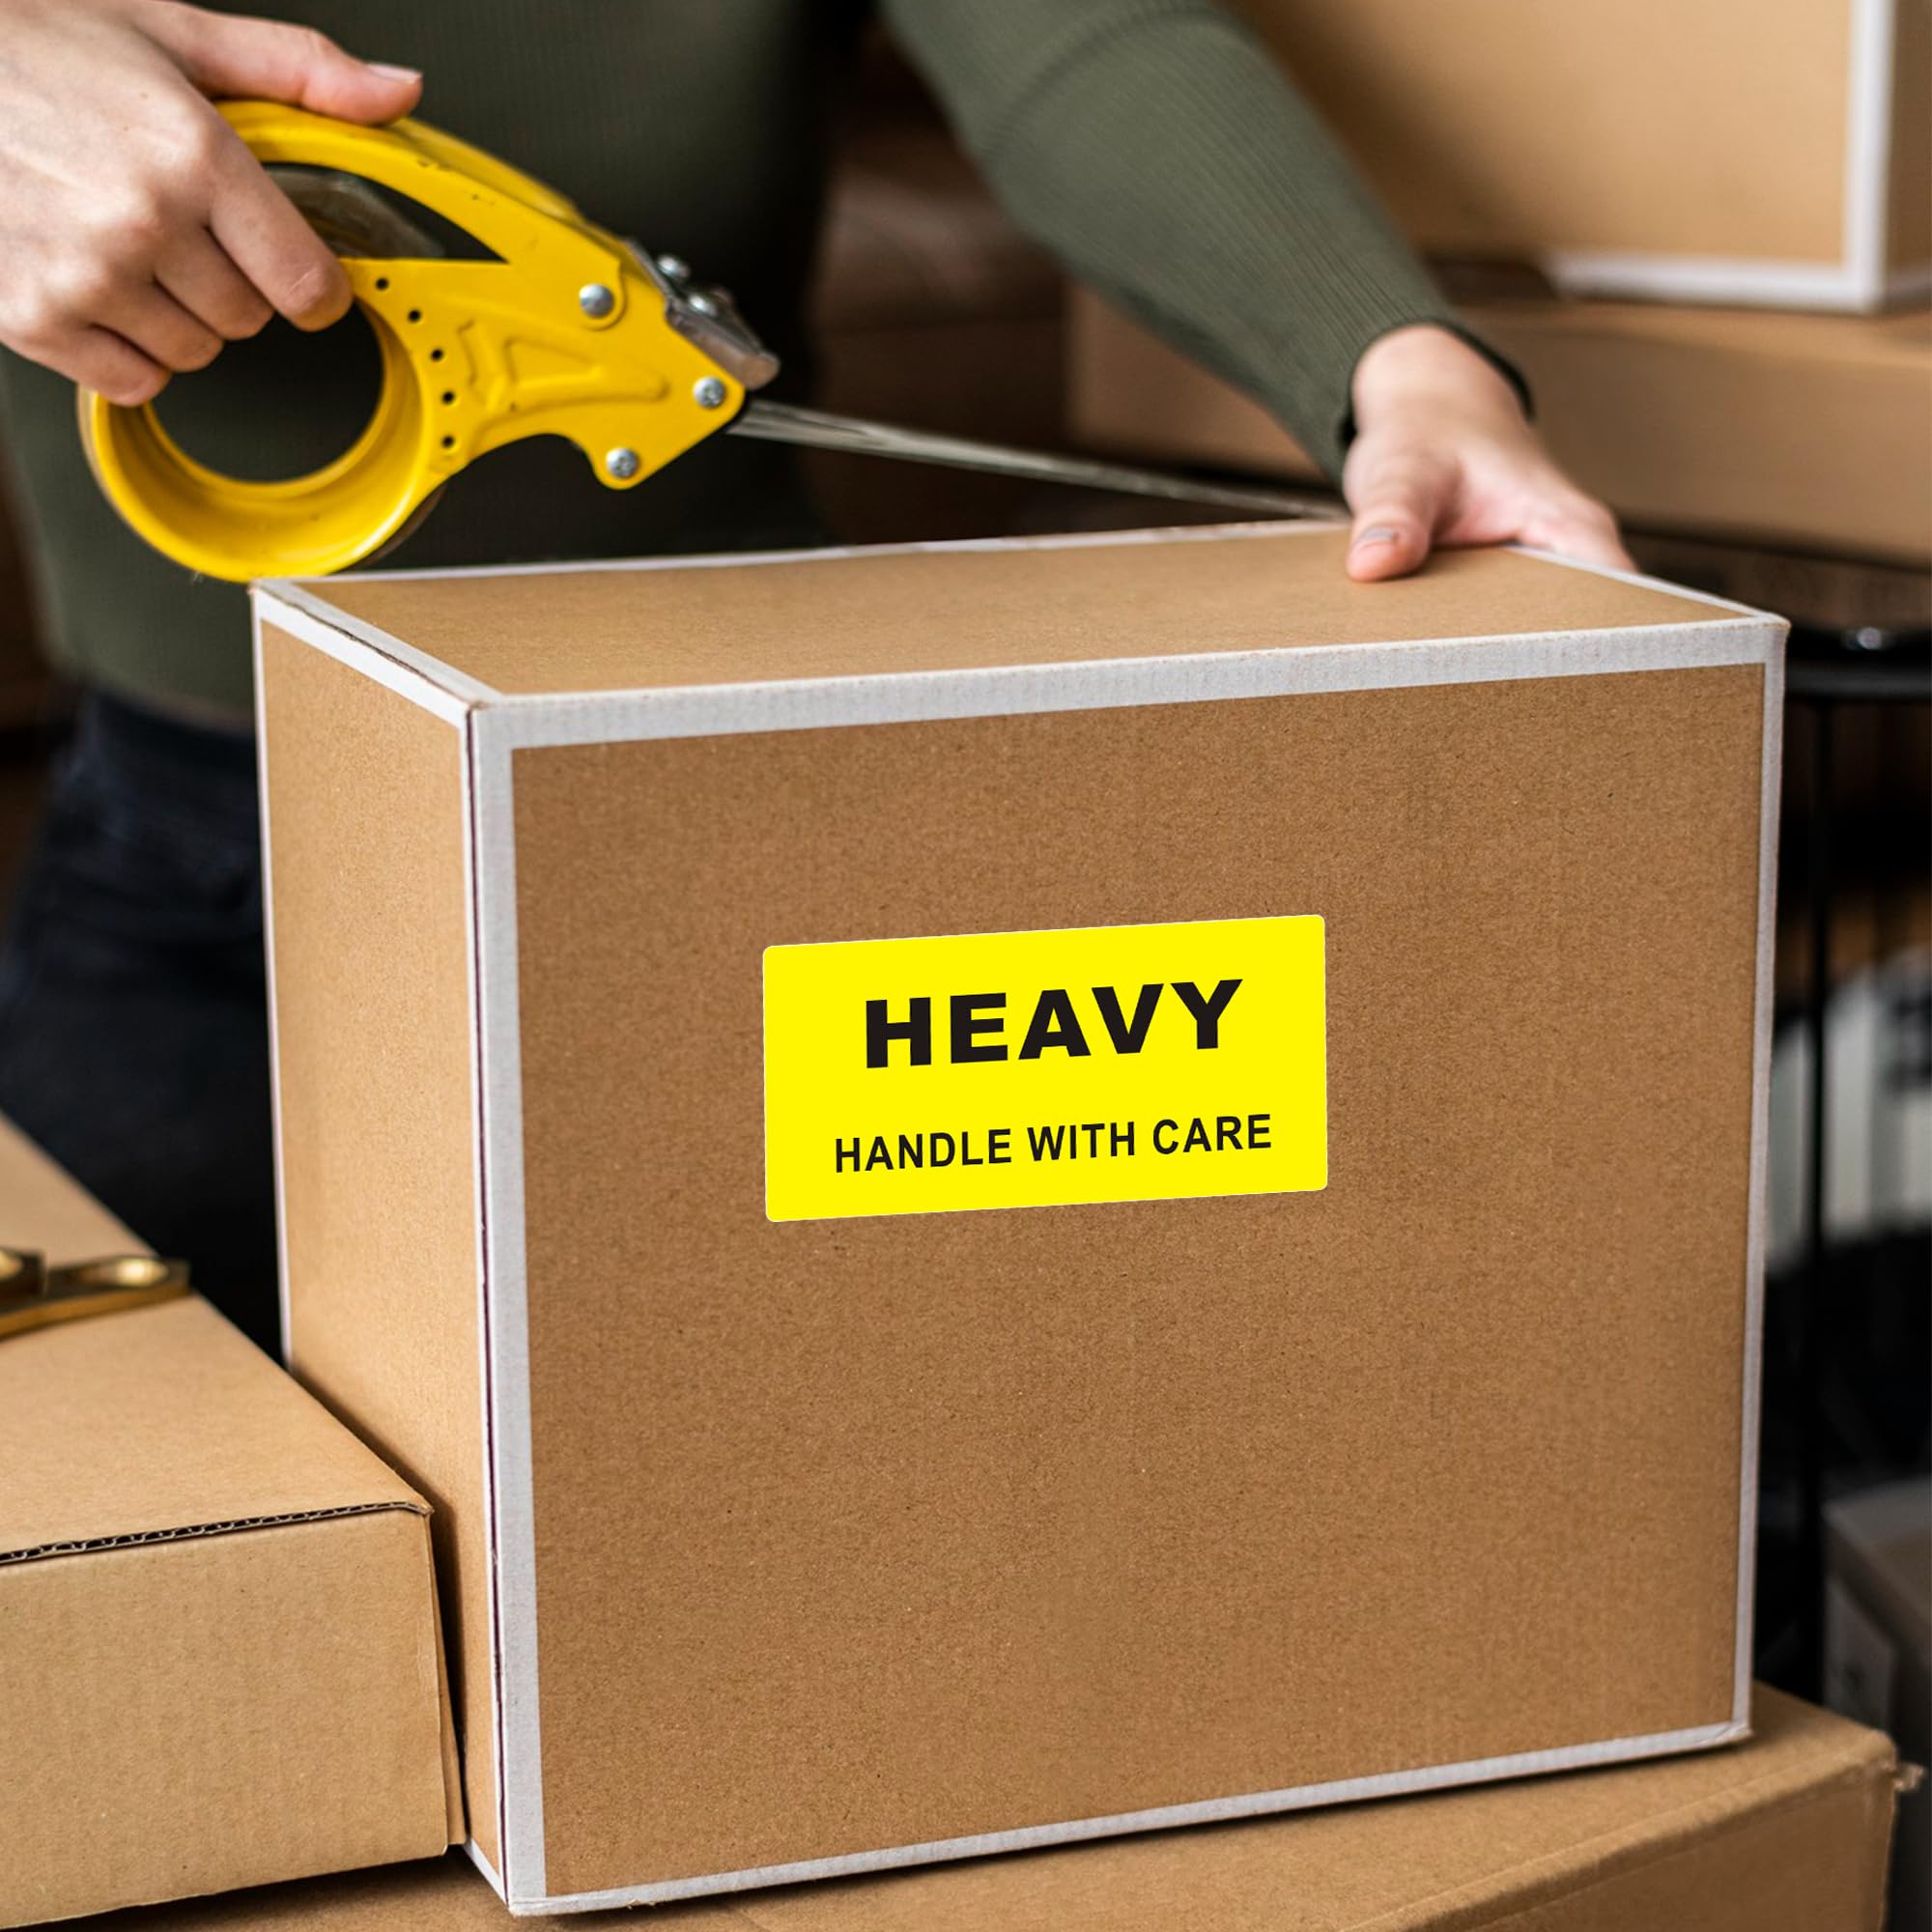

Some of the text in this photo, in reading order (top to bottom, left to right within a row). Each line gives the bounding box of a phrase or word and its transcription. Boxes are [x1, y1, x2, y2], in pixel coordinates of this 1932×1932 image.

[866, 979, 1244, 1069] HEAVY
[836, 1114, 1271, 1174] HANDLE WITH CARE
